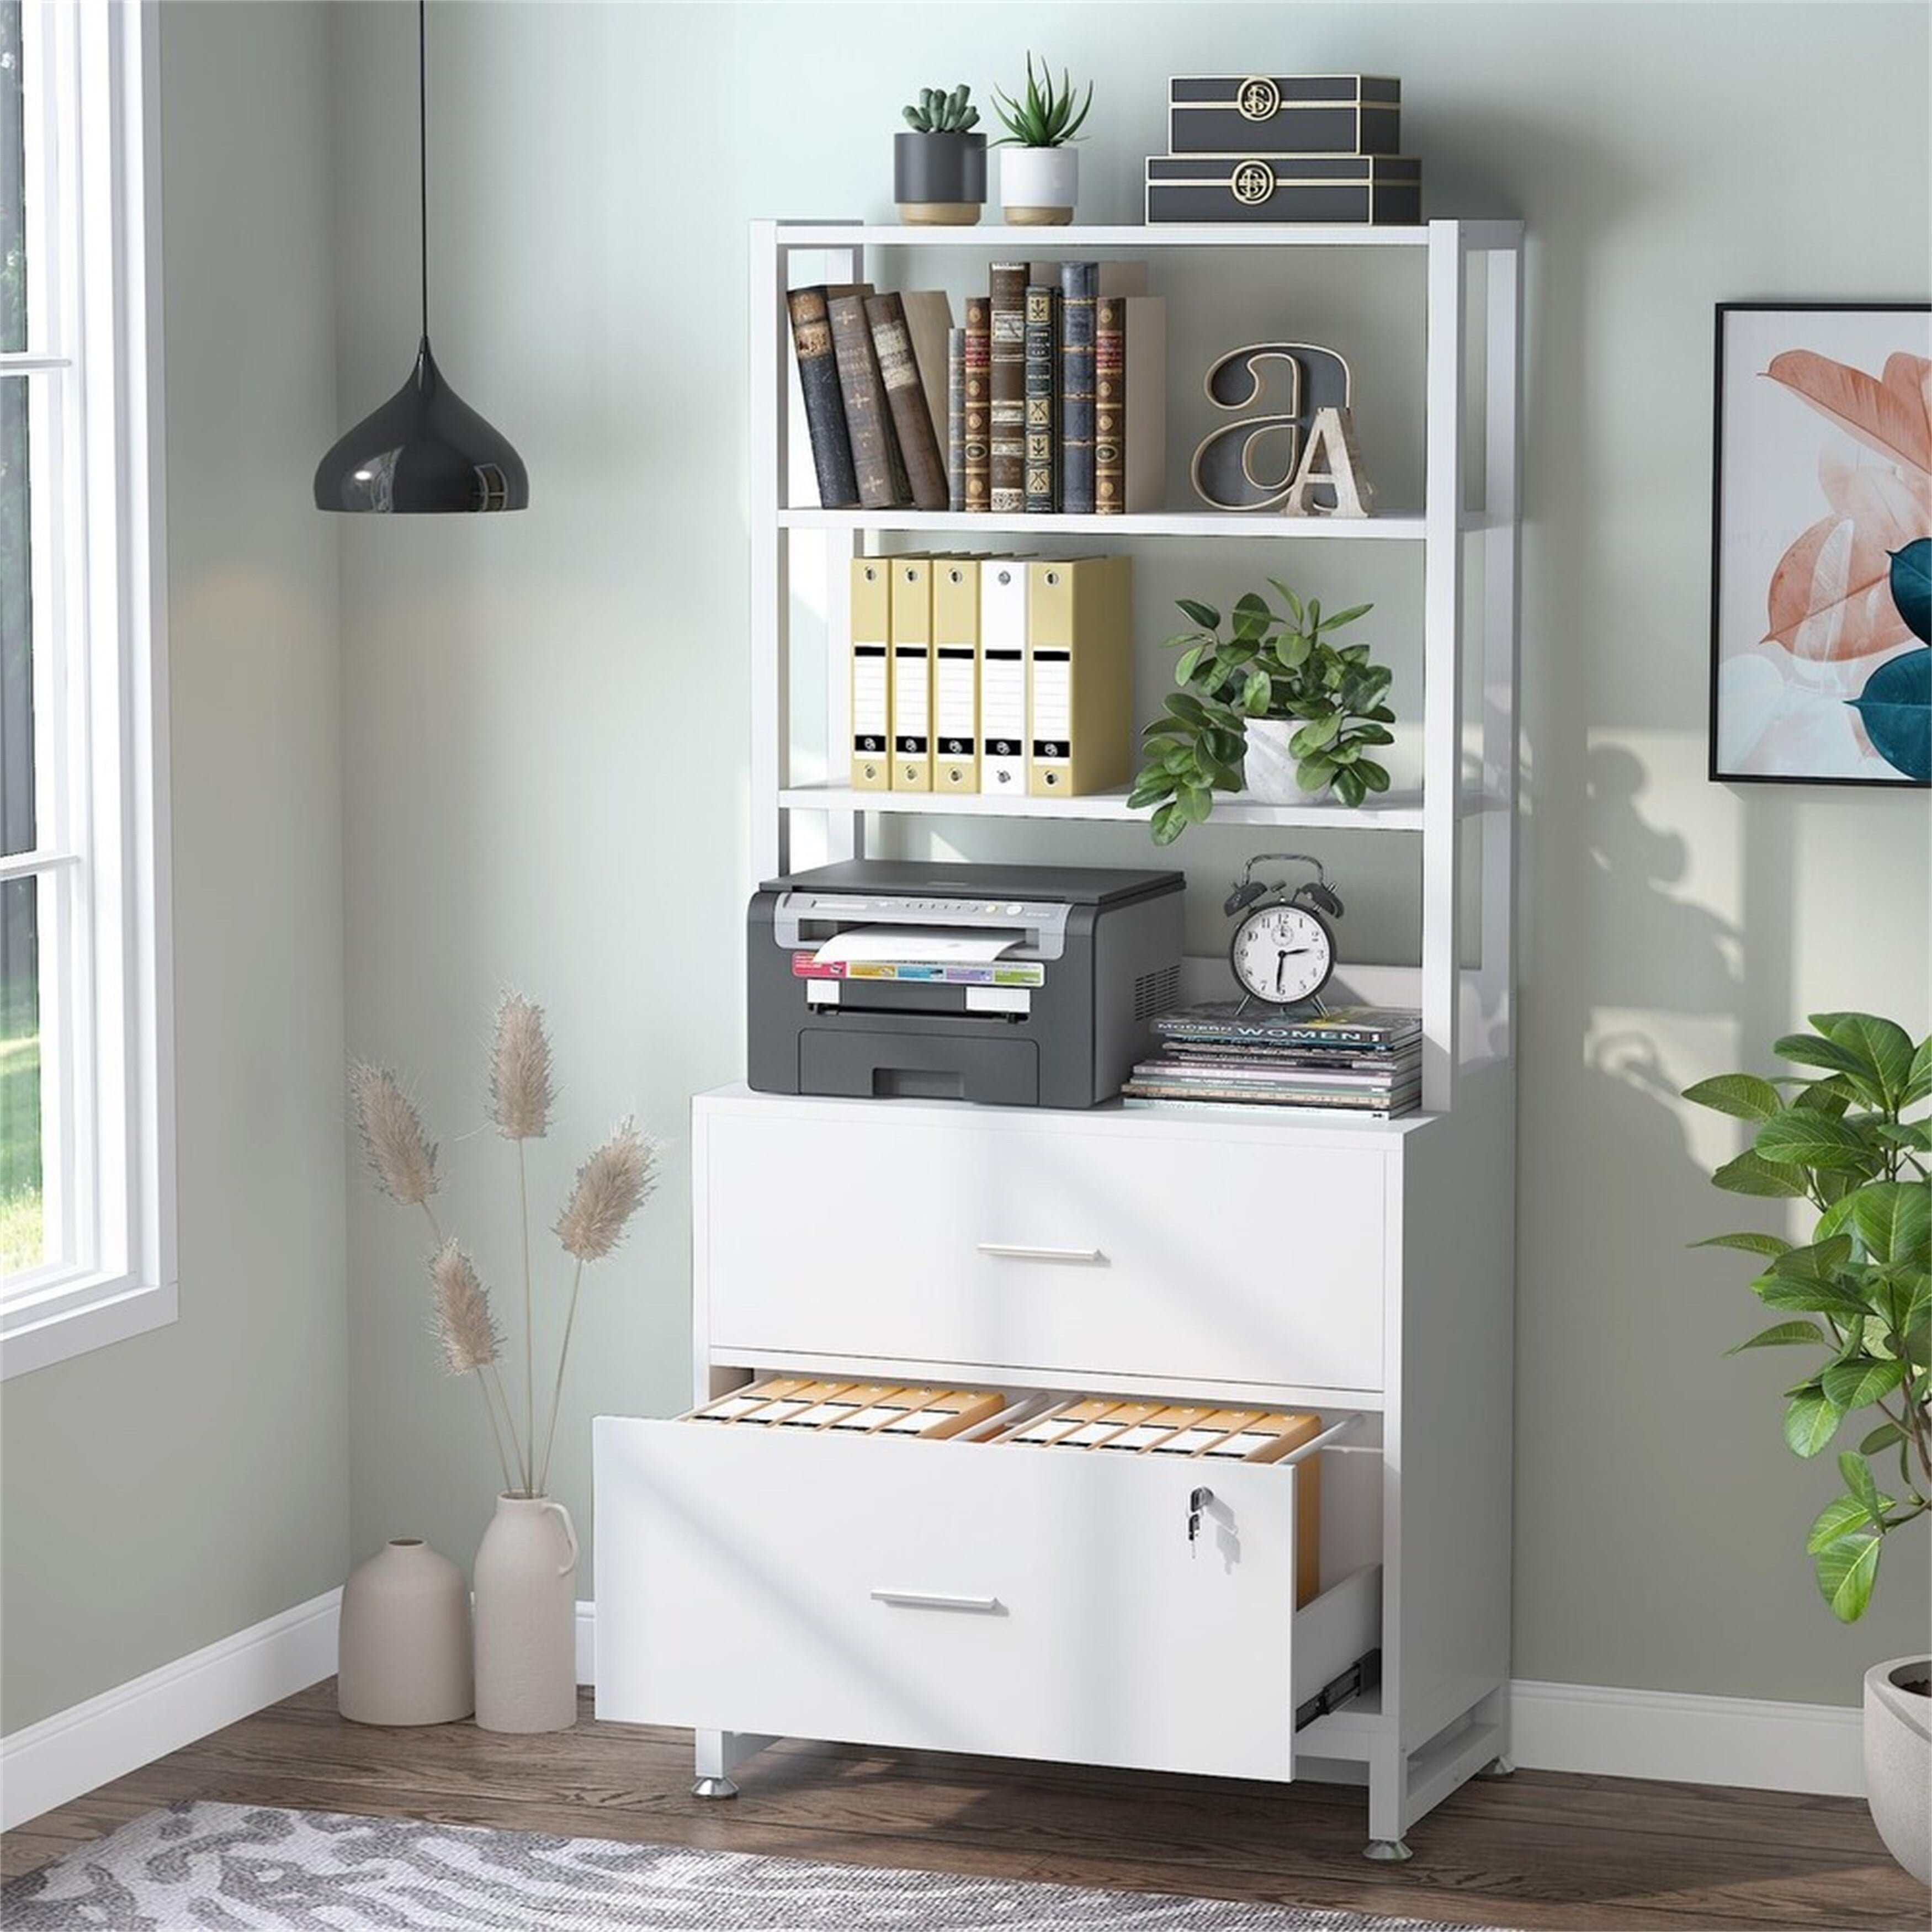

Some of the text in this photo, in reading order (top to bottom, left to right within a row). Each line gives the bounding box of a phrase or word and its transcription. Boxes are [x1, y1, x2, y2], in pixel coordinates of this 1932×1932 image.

[1191, 342, 1373, 511] a
[1280, 407, 1368, 517] A
[1262, 917, 1270, 928] 11
[1278, 913, 1289, 925] 12
[1299, 917, 1303, 928] 1
[1312, 931, 1319, 942] 2
[1317, 949, 1324, 960] 3
[1237, 1027, 1361, 1041] WOMEN
